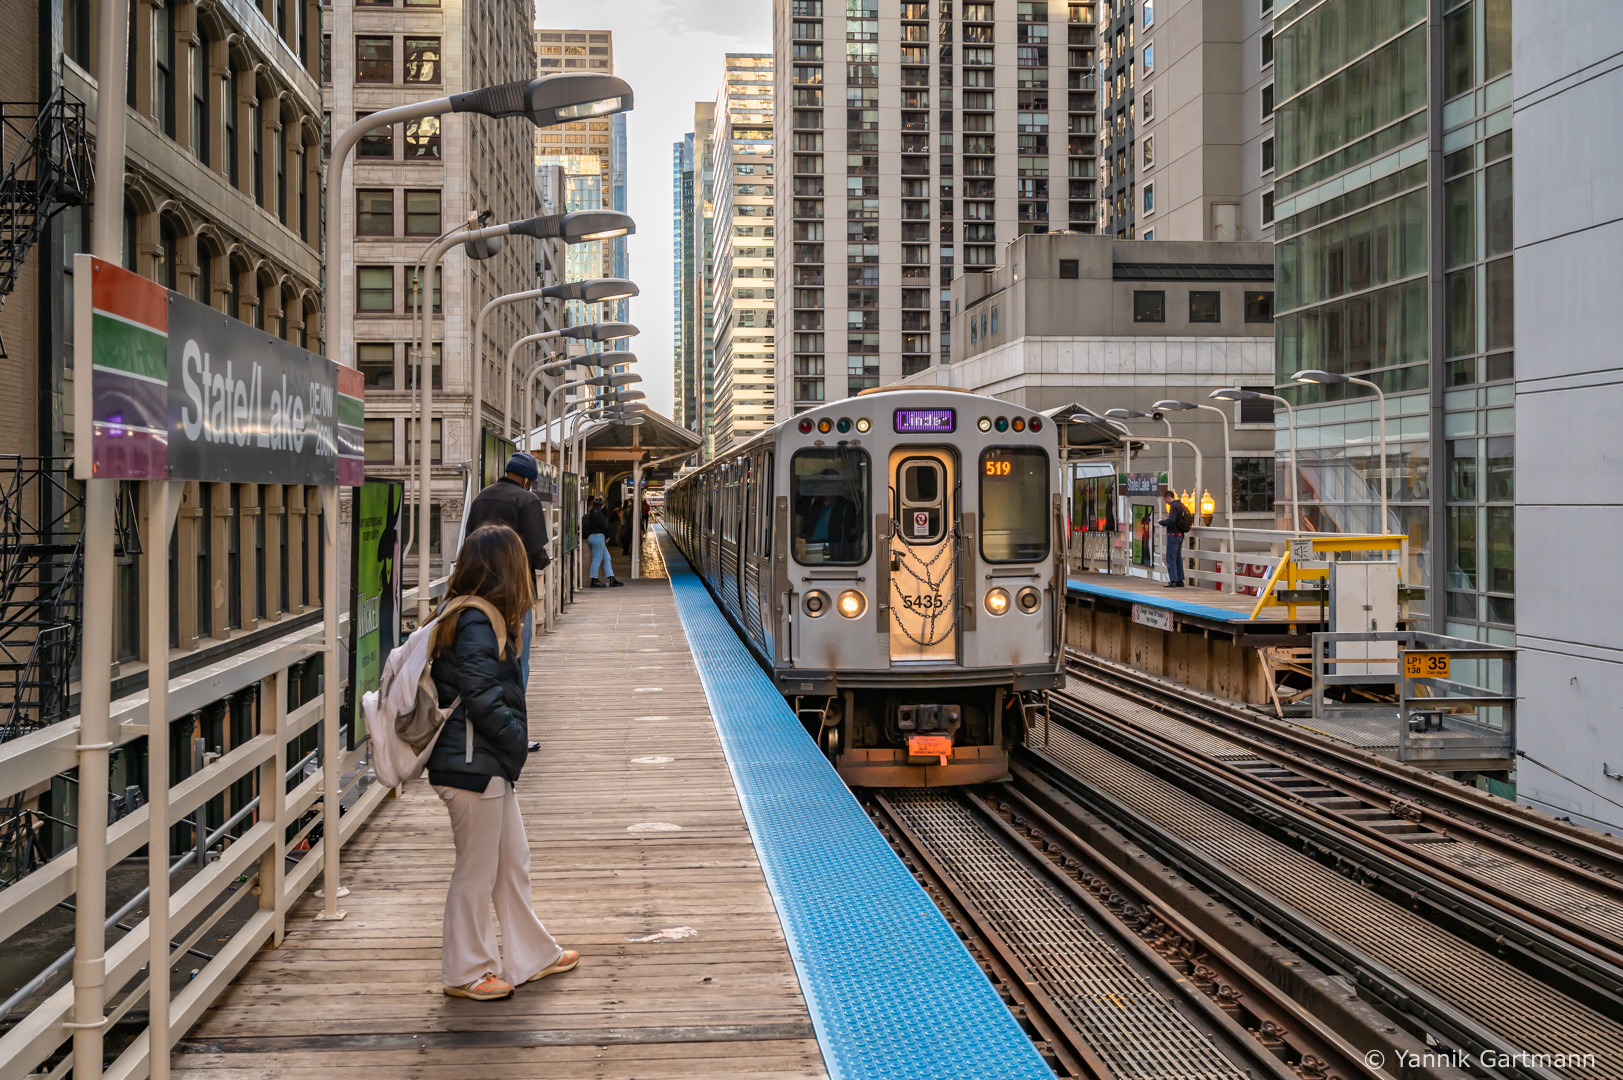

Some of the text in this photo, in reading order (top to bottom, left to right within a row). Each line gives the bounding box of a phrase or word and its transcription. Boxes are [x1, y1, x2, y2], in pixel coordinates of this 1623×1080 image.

[182, 339, 304, 453] State/Lake
[986, 461, 1011, 475] 519
[903, 594, 943, 609] 5435
[1407, 656, 1447, 670] LP1 35
